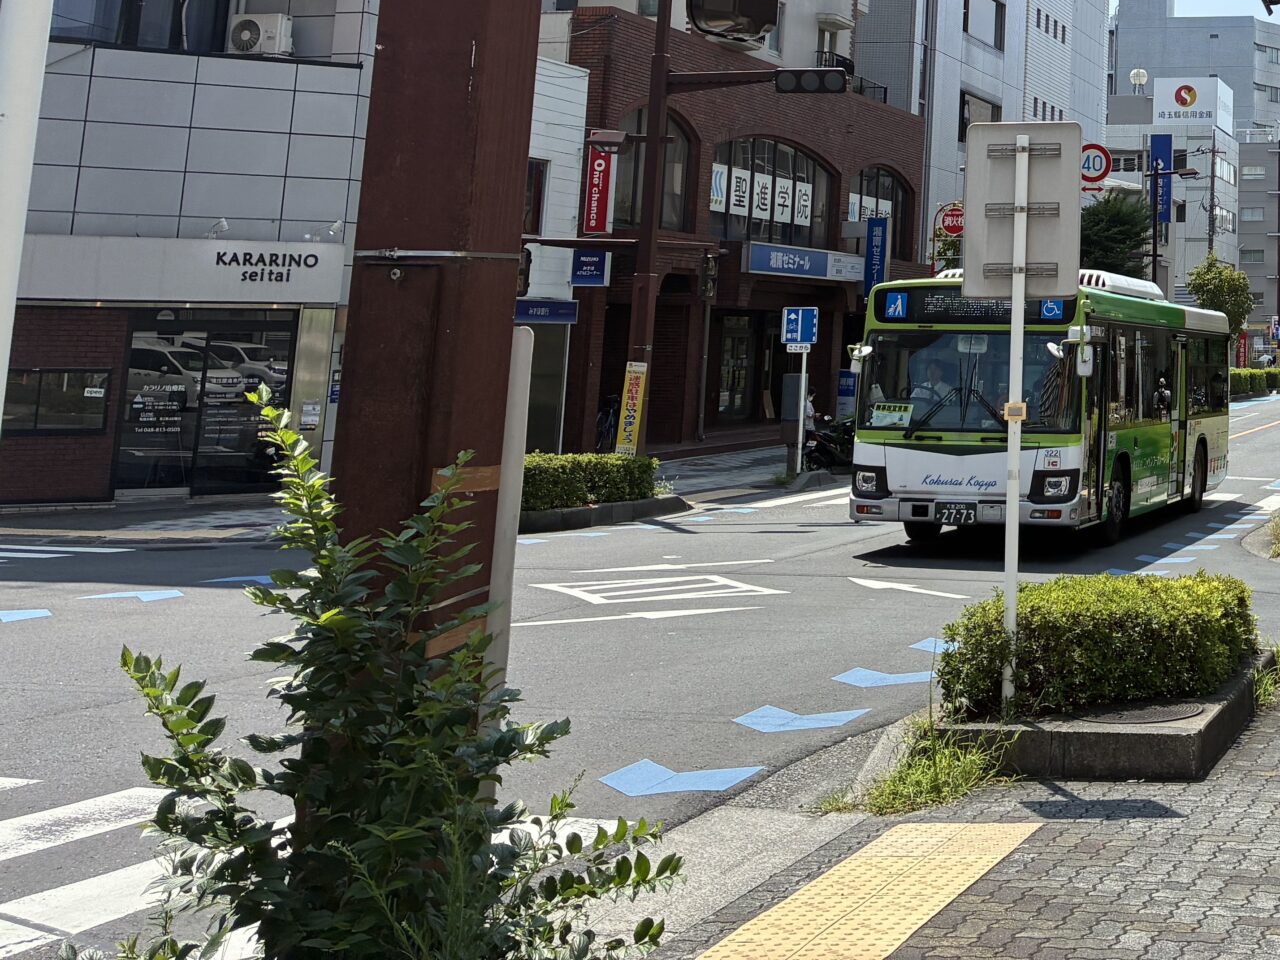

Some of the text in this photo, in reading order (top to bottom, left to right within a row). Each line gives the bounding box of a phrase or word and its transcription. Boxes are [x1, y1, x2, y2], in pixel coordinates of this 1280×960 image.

[1082, 154, 1103, 172] 40
[733, 175, 810, 220] 聖進学院
[215, 251, 319, 268] KARARINO
[769, 251, 811, 271] 湘南ゼミナール
[240, 268, 291, 282] seitai
[787, 344, 810, 352] ここから
[921, 474, 998, 491] Kokusai Kogyo
[941, 509, 976, 524] 27-73
